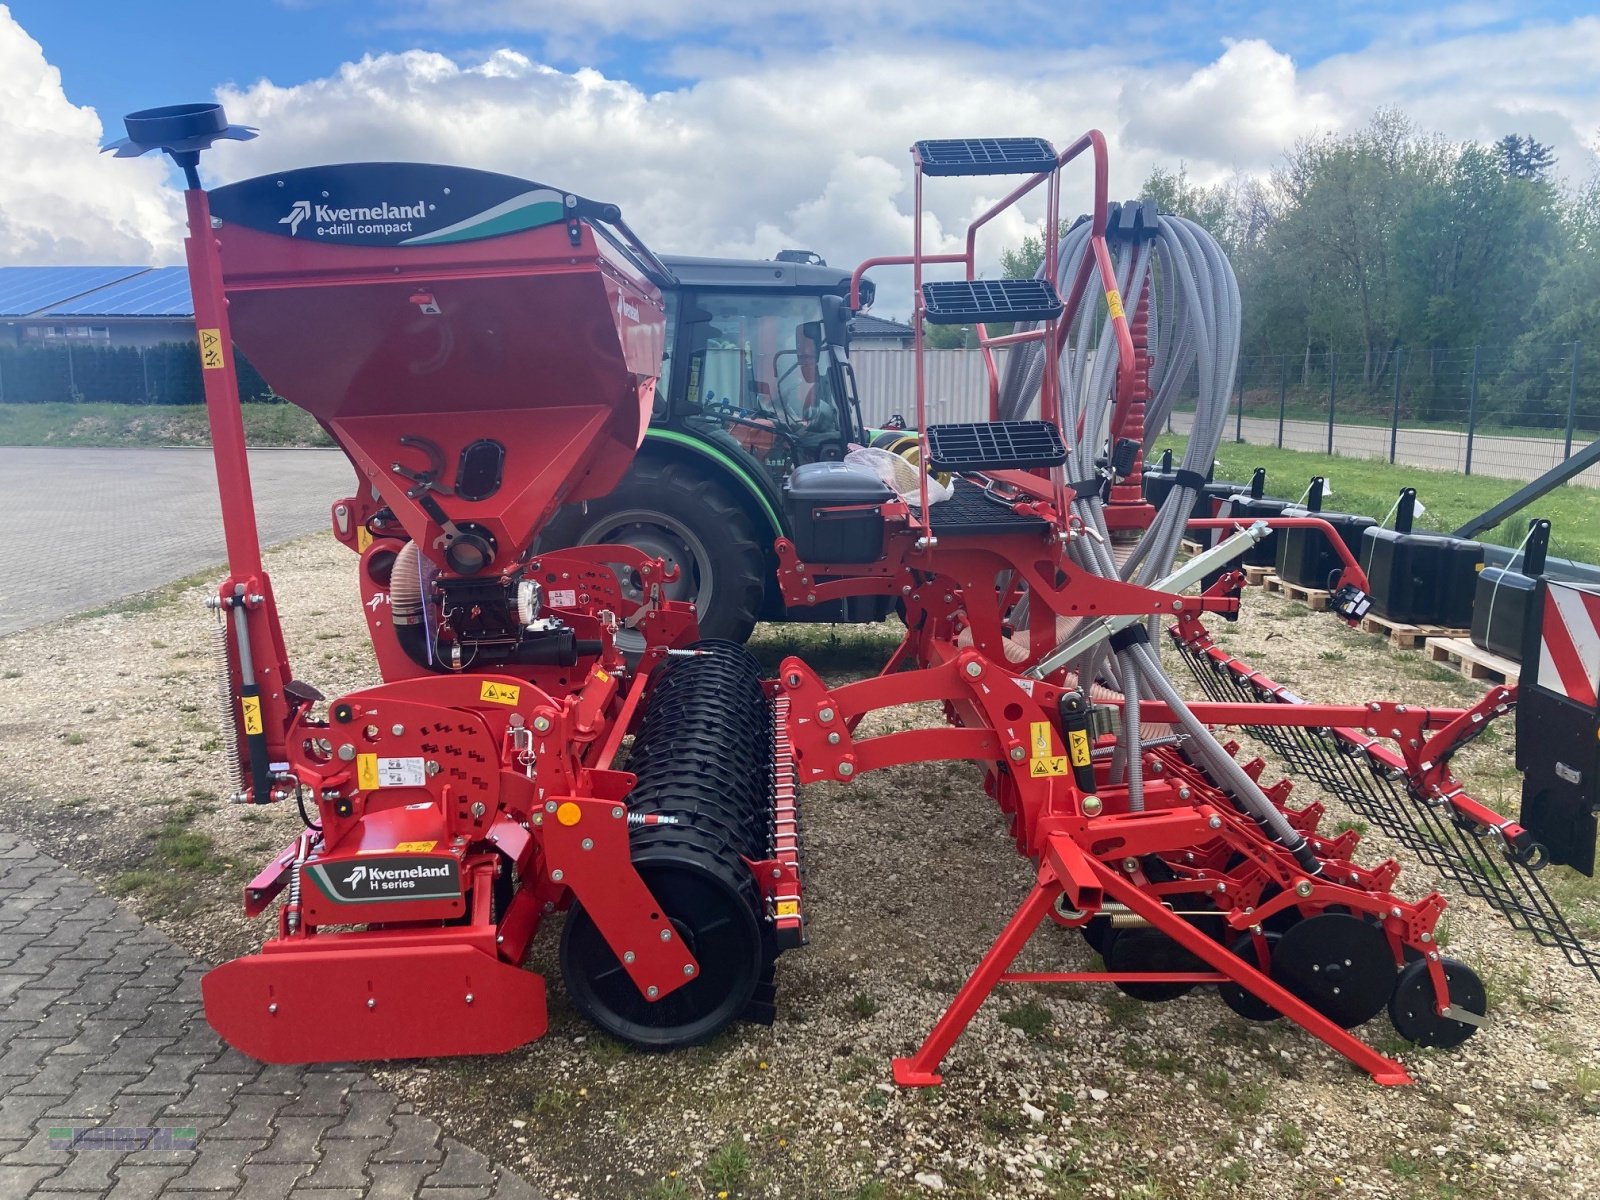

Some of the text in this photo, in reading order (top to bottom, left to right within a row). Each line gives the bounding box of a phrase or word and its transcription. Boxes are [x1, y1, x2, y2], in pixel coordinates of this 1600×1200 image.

[315, 201, 426, 222] Kverneland
[317, 221, 412, 235] e-drill compact
[369, 864, 450, 880] Kverneland
[370, 880, 415, 890] H series
